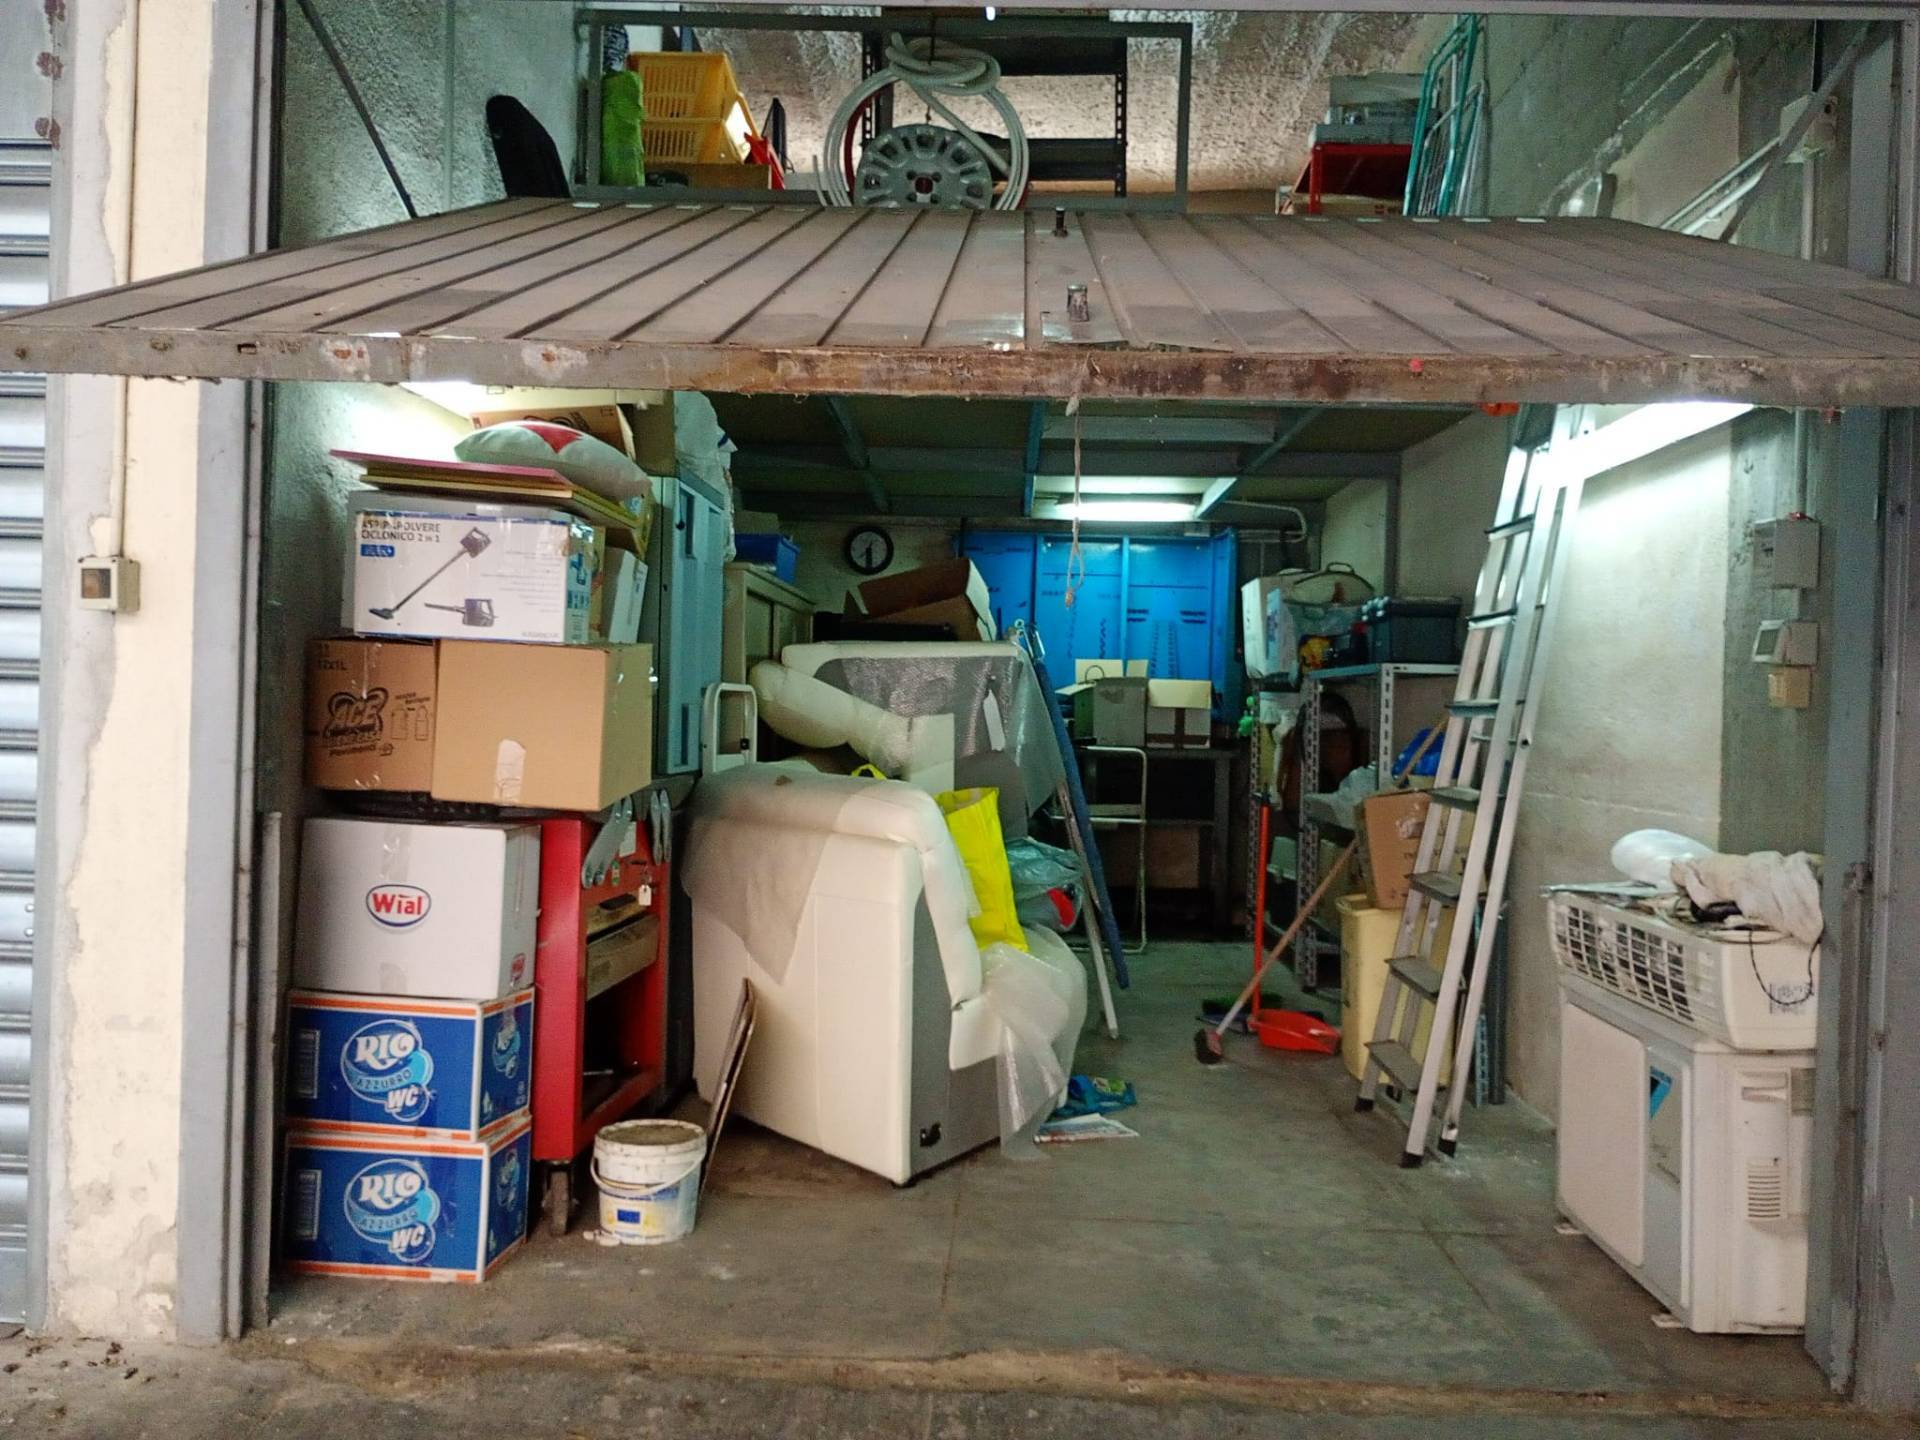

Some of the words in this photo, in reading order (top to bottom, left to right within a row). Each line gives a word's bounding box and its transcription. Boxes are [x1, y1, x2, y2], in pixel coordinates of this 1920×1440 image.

[372, 892, 423, 915] Wial
[354, 1032, 416, 1071] RIO
[386, 1085, 420, 1112] WC
[359, 1171, 421, 1210] RIO
[389, 1223, 426, 1252] WC
